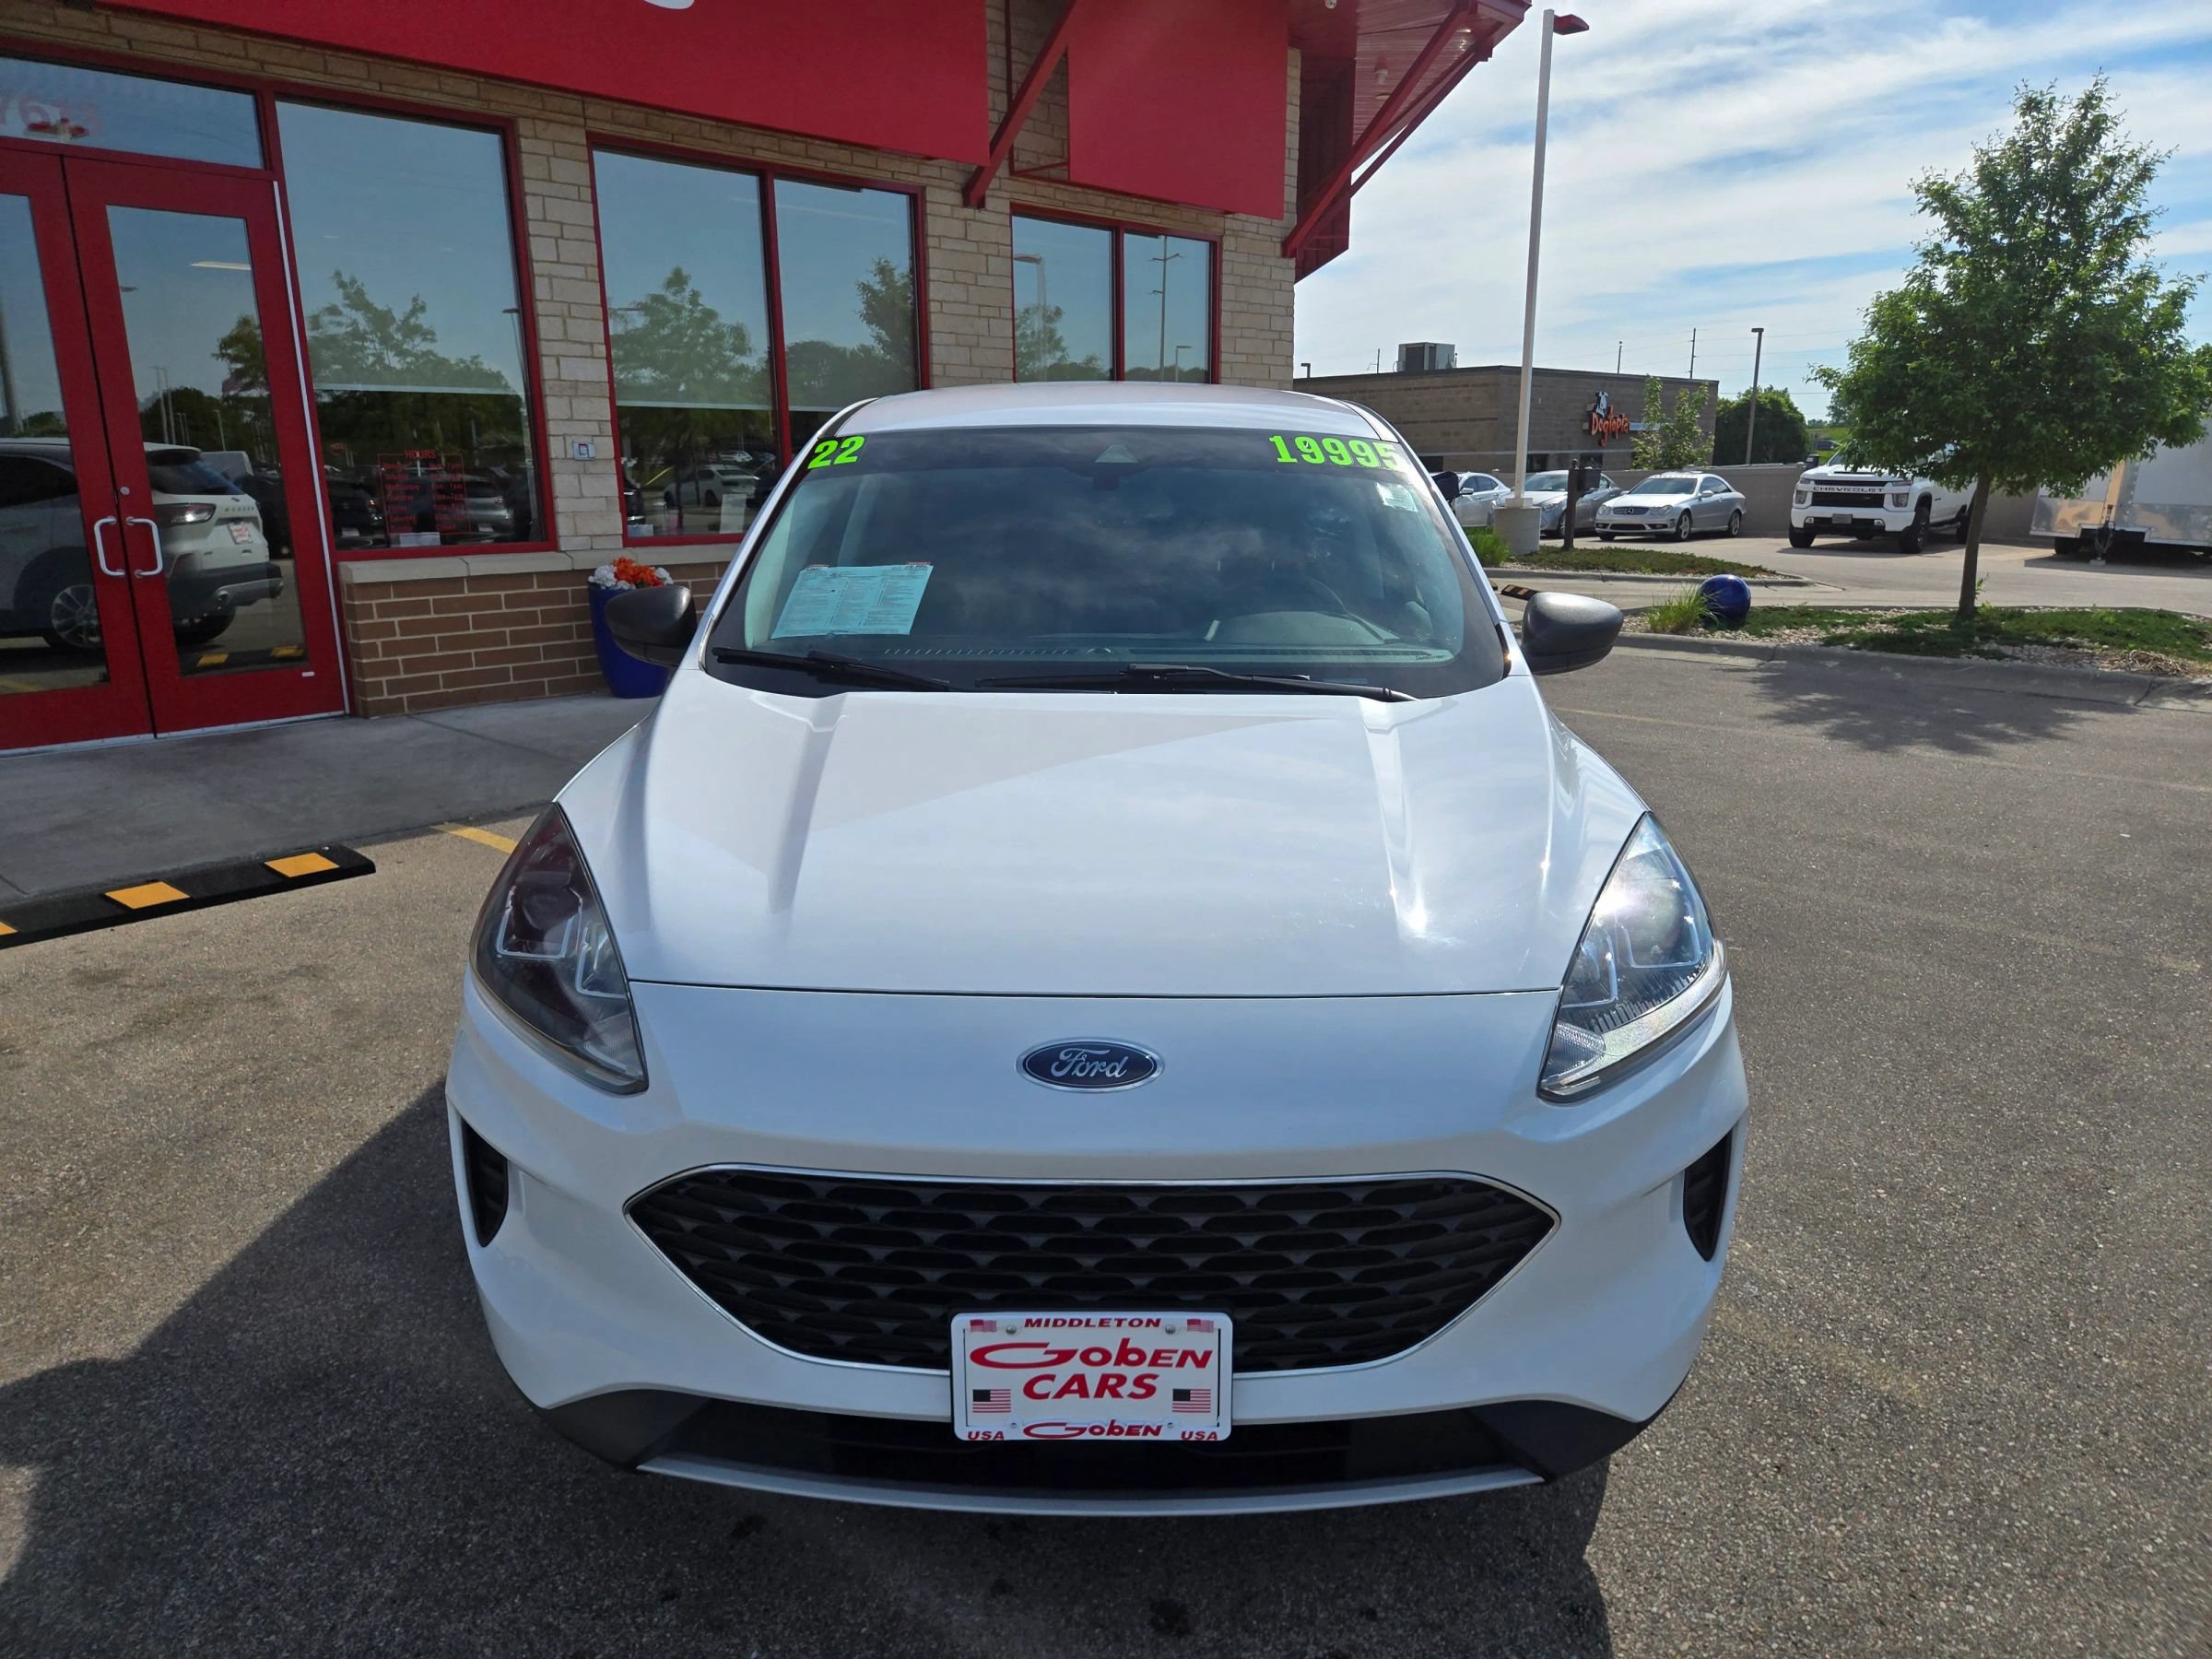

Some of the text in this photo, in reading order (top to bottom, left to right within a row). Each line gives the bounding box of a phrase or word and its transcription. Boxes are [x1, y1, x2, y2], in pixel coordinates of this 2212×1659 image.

[405, 450, 436, 459] HOURS
[808, 436, 865, 469] 22
[1269, 436, 1398, 471] 19995
[1050, 1047, 1129, 1078] Ford
[1024, 1318, 1162, 1328] MIDDLETON
[1023, 1373, 1159, 1400] CARS
[968, 1430, 1005, 1441] USA
[1181, 1430, 1219, 1441] USA
